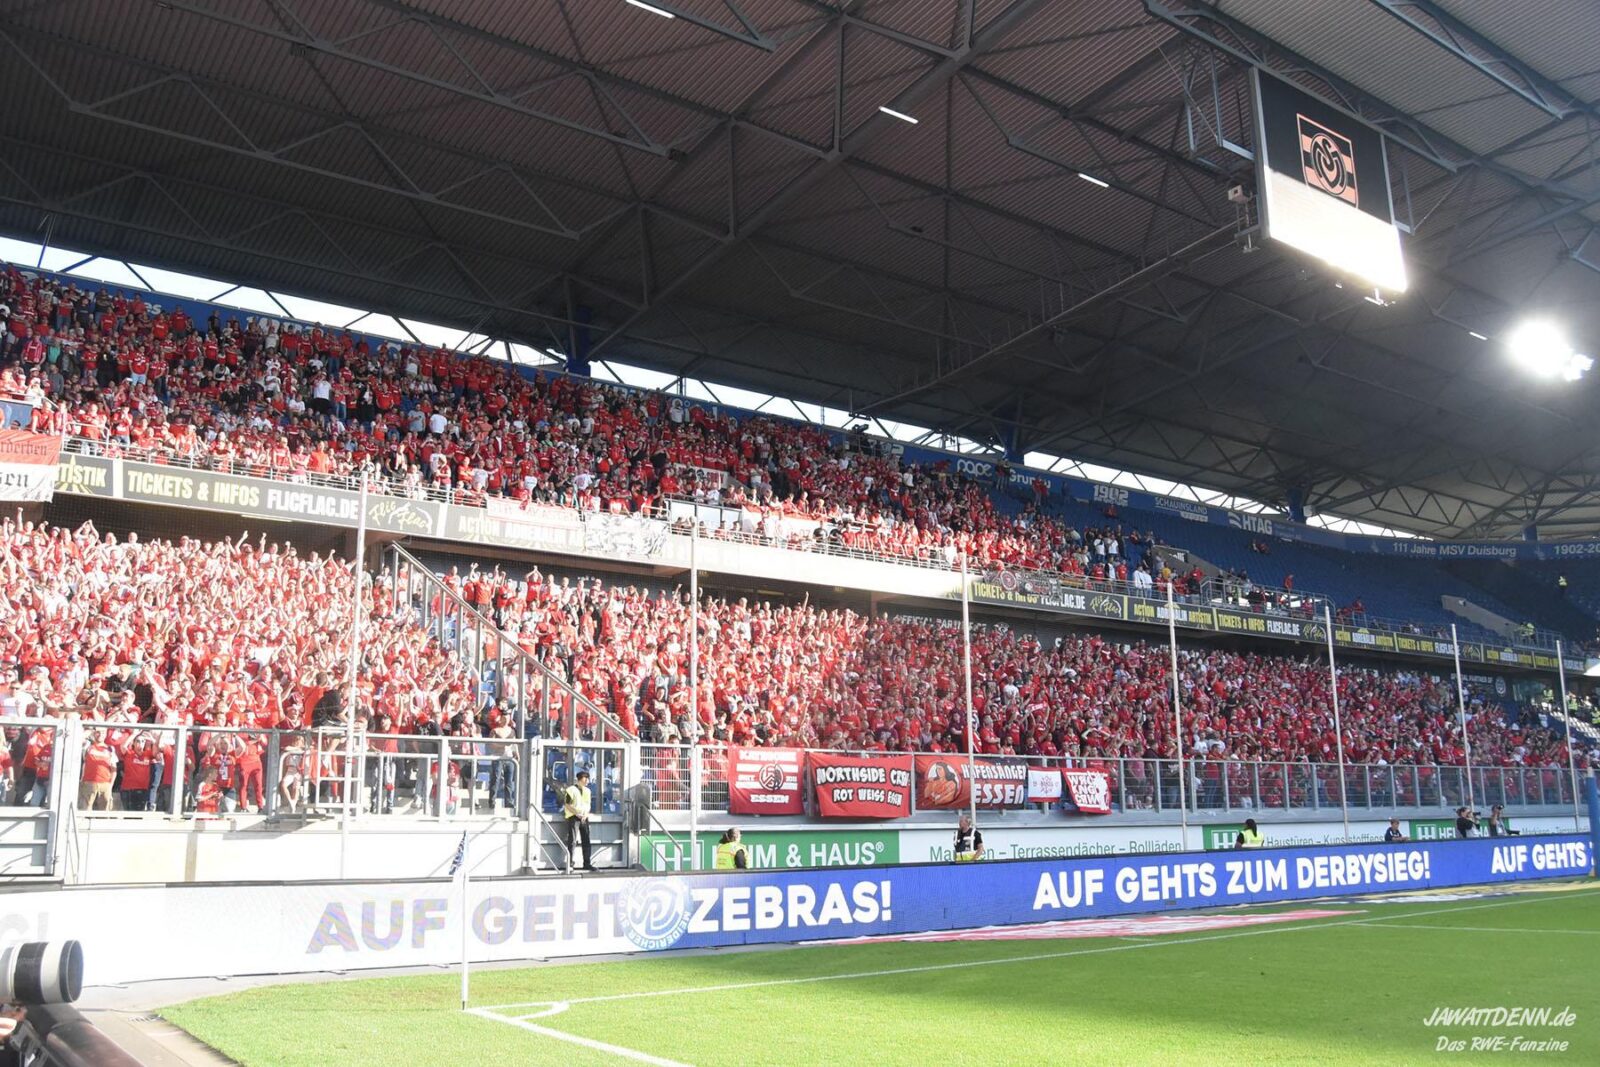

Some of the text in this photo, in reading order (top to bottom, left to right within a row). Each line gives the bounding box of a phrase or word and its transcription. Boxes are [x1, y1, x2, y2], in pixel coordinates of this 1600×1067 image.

[55, 462, 107, 488] TISTIK
[127, 470, 359, 520] TICKETS & INFOS FLICFLAC.DE
[1154, 496, 1208, 515] SCHAUINSLAND
[459, 515, 500, 535] ACTION
[1242, 514, 1273, 536] HTAG
[1411, 544, 1436, 556] Jahre
[1439, 545, 1465, 556] MSV
[1468, 545, 1517, 558] Duisburg
[816, 766, 886, 785] NORTHSIDE
[833, 788, 854, 803] ROT
[857, 788, 885, 803] WEISS
[974, 783, 1024, 805] ESSEN
[785, 843, 802, 868] &
[1010, 842, 1116, 859] Terrassendächer
[1491, 845, 1528, 875] AUF
[1532, 841, 1587, 870] GEHTS
[1033, 850, 1431, 911] AUF GEHTS ZUM DERBYSIEG!
[687, 880, 893, 934] ZEBRAS!
[305, 898, 449, 954] AUF
